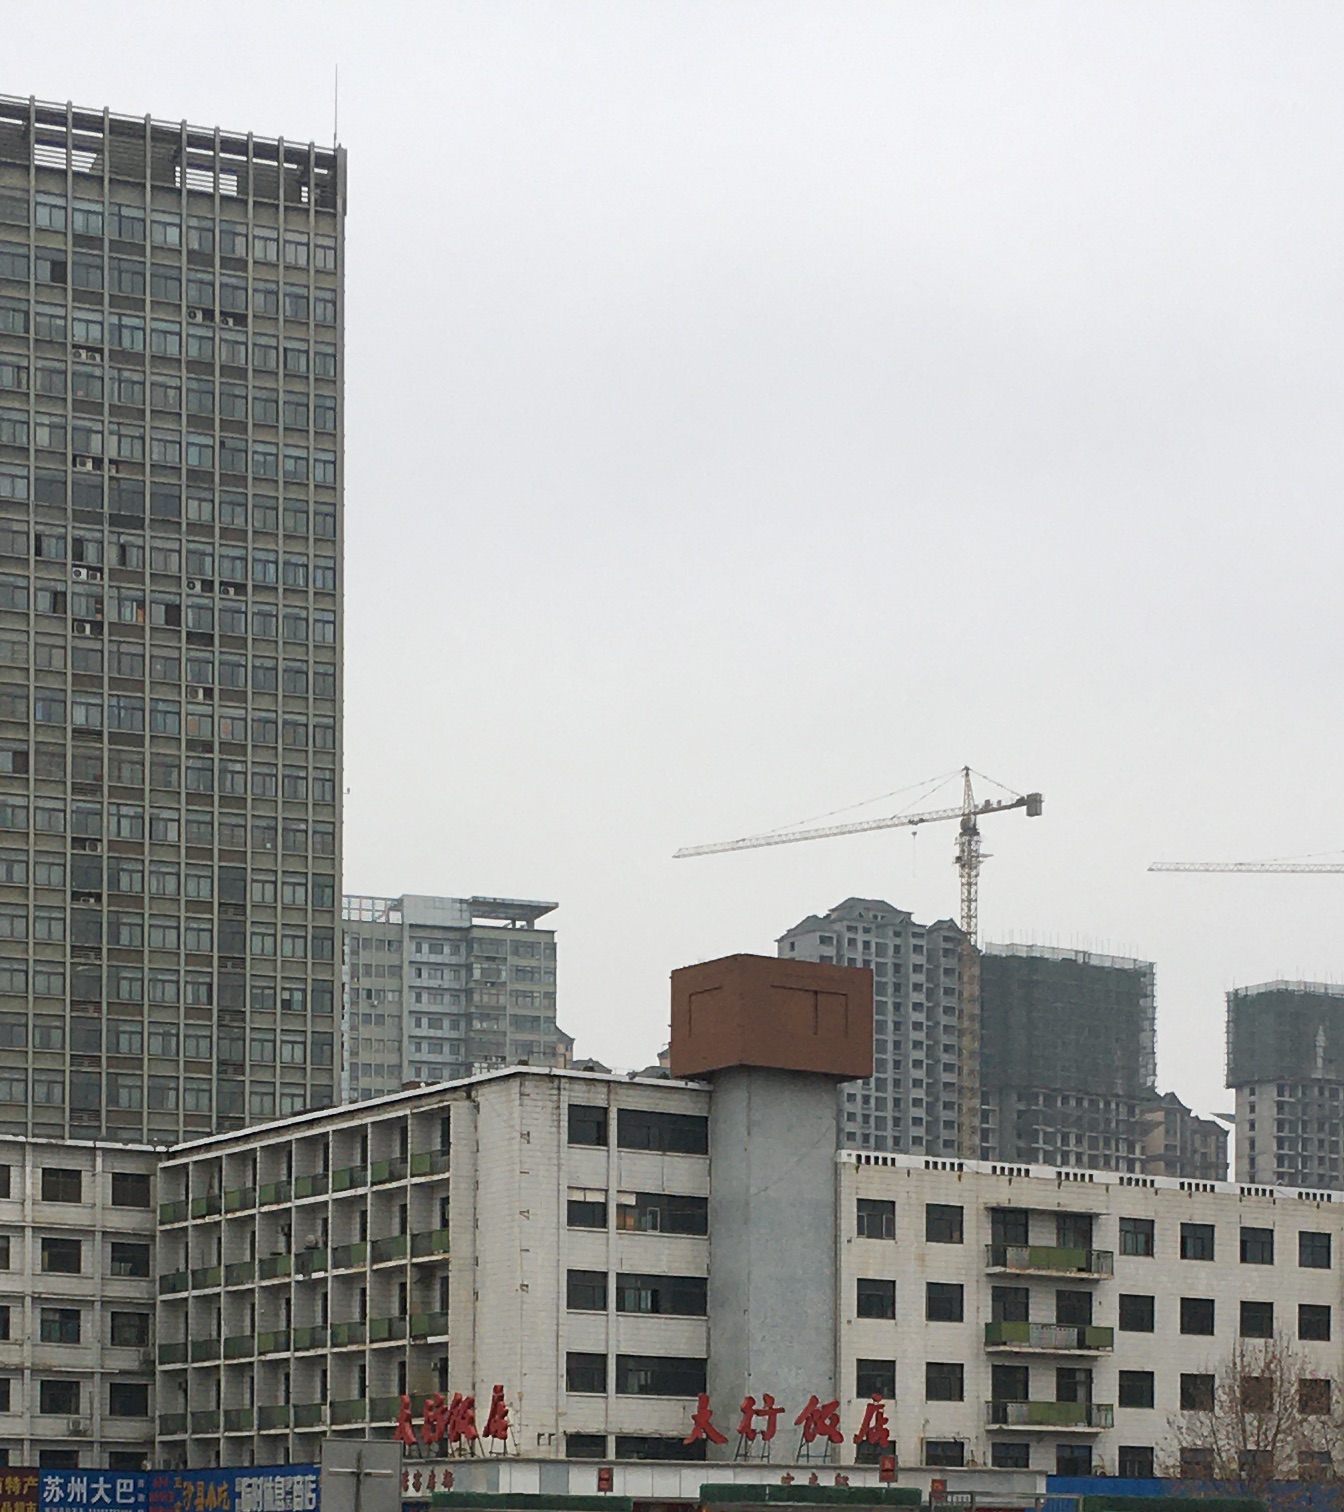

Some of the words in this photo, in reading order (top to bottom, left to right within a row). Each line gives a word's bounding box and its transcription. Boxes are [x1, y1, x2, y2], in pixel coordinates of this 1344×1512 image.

[682, 1392, 891, 1448] 太行饭店
[43, 1475, 136, 1504] 苏州大巴
